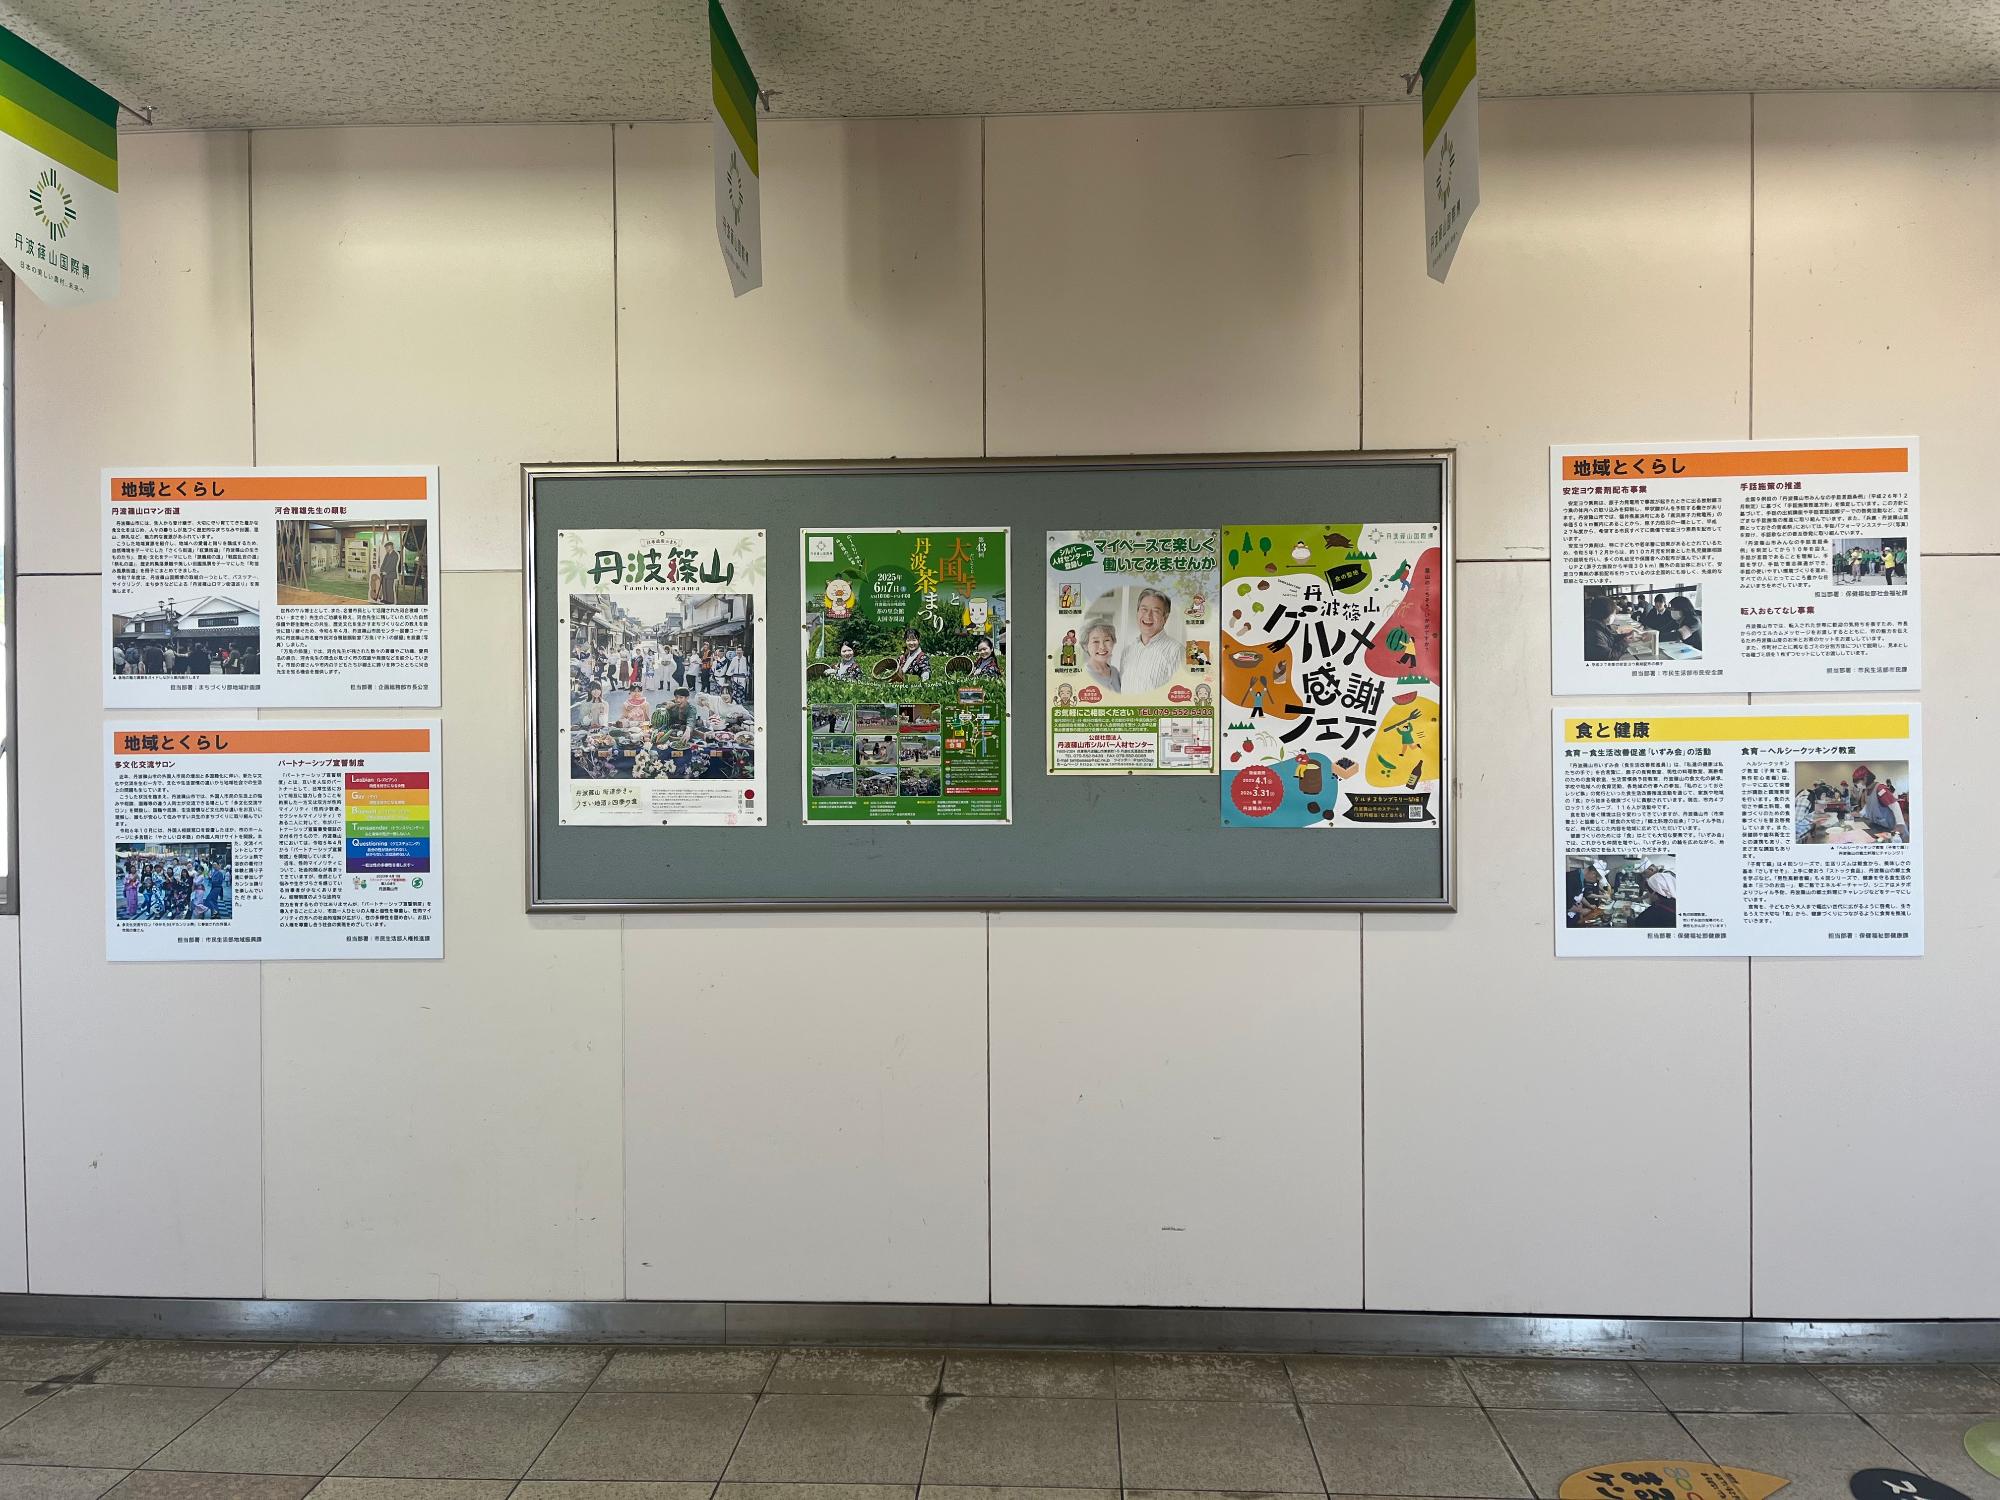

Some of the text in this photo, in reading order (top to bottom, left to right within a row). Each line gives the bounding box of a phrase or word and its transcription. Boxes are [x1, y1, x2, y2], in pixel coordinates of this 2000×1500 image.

[15, 232, 90, 280] 丹波篠山国際博
[1574, 458, 1686, 476] 地域とくらし
[122, 481, 225, 498] 地域とくらし
[1563, 486, 1647, 495] 安定ヨウ素剤配布事業
[1740, 482, 1802, 491] 手話施策の推進
[1059, 546, 1082, 555] シルバー
[1094, 538, 1215, 553] マイペースで楽しく
[587, 547, 734, 586] 丹波篠山
[1052, 552, 1093, 565] 人材センターに
[1103, 557, 1216, 572] 働いてみませんか
[874, 582, 899, 592] 6月7日
[1304, 584, 1380, 621] 丹波篠山
[1740, 606, 1815, 616] 転入おもてなし事業
[1262, 604, 1376, 666] グルメ
[1302, 662, 1385, 716] 感謝
[1279, 704, 1376, 750] フェア
[1576, 722, 1650, 738] 食と健康
[124, 735, 228, 752] 地域とくらし
